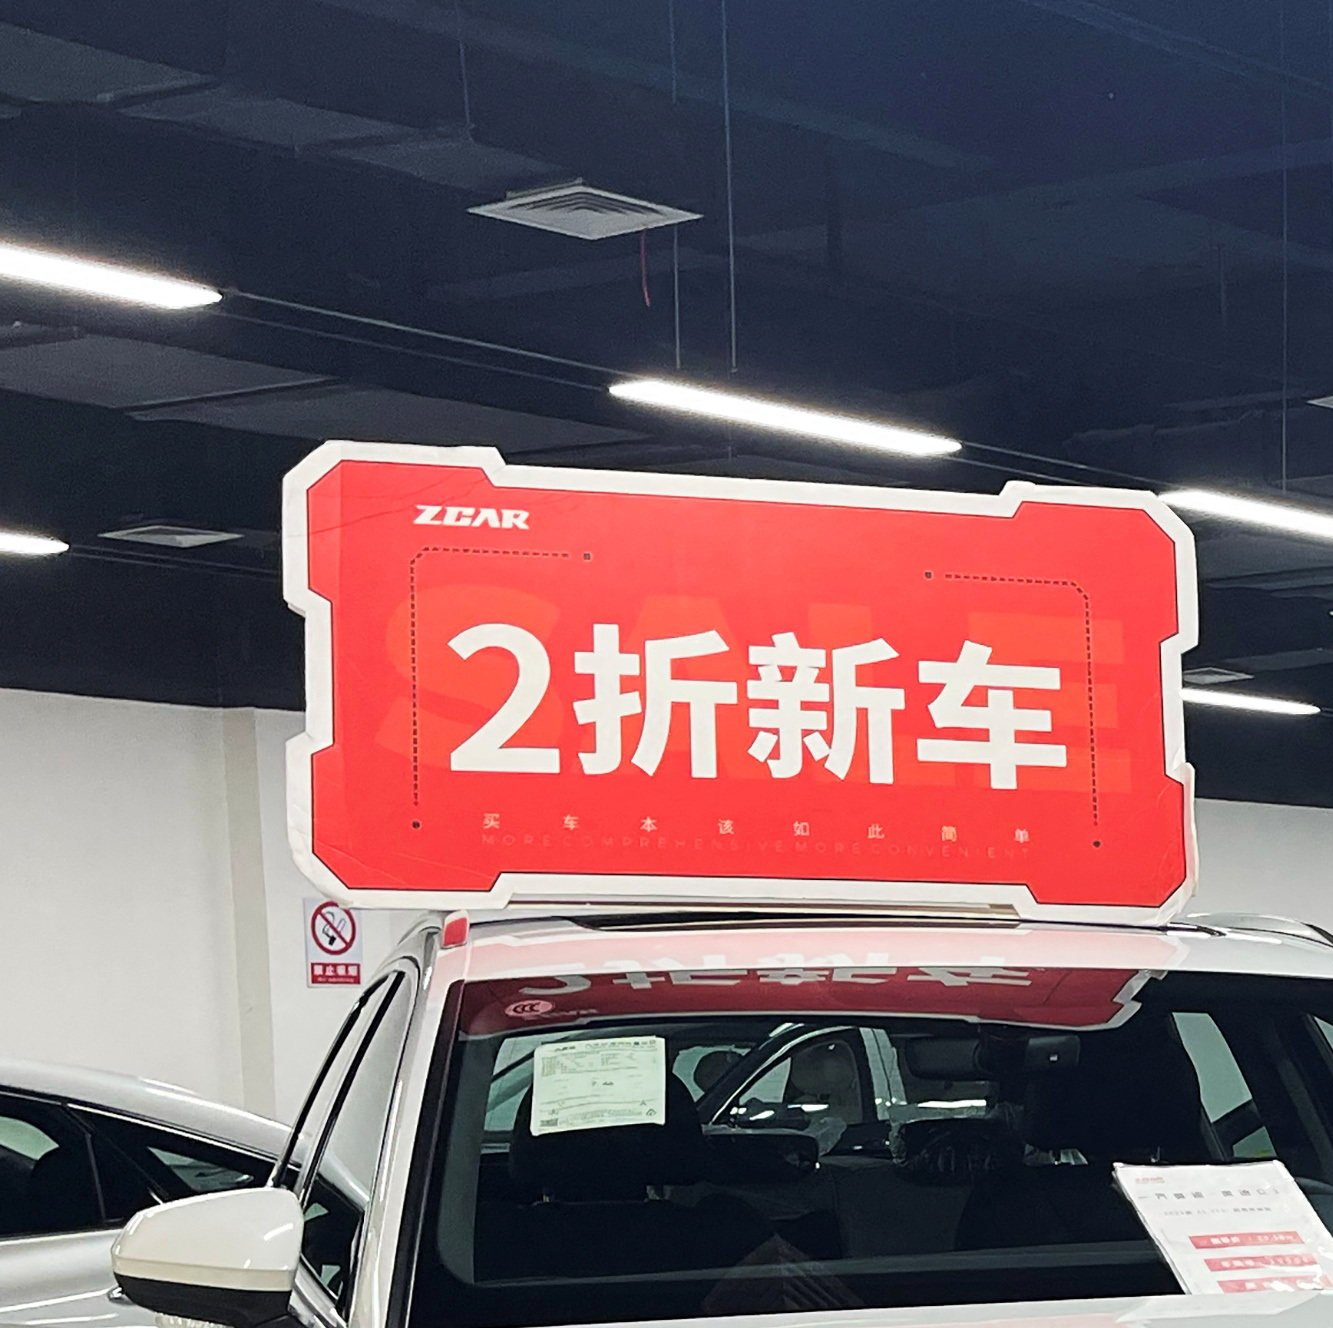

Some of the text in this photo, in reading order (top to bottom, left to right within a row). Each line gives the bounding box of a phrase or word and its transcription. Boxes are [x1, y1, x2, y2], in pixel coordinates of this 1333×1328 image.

[413, 504, 529, 530] ZCAR
[447, 623, 1068, 790] 2折新车
